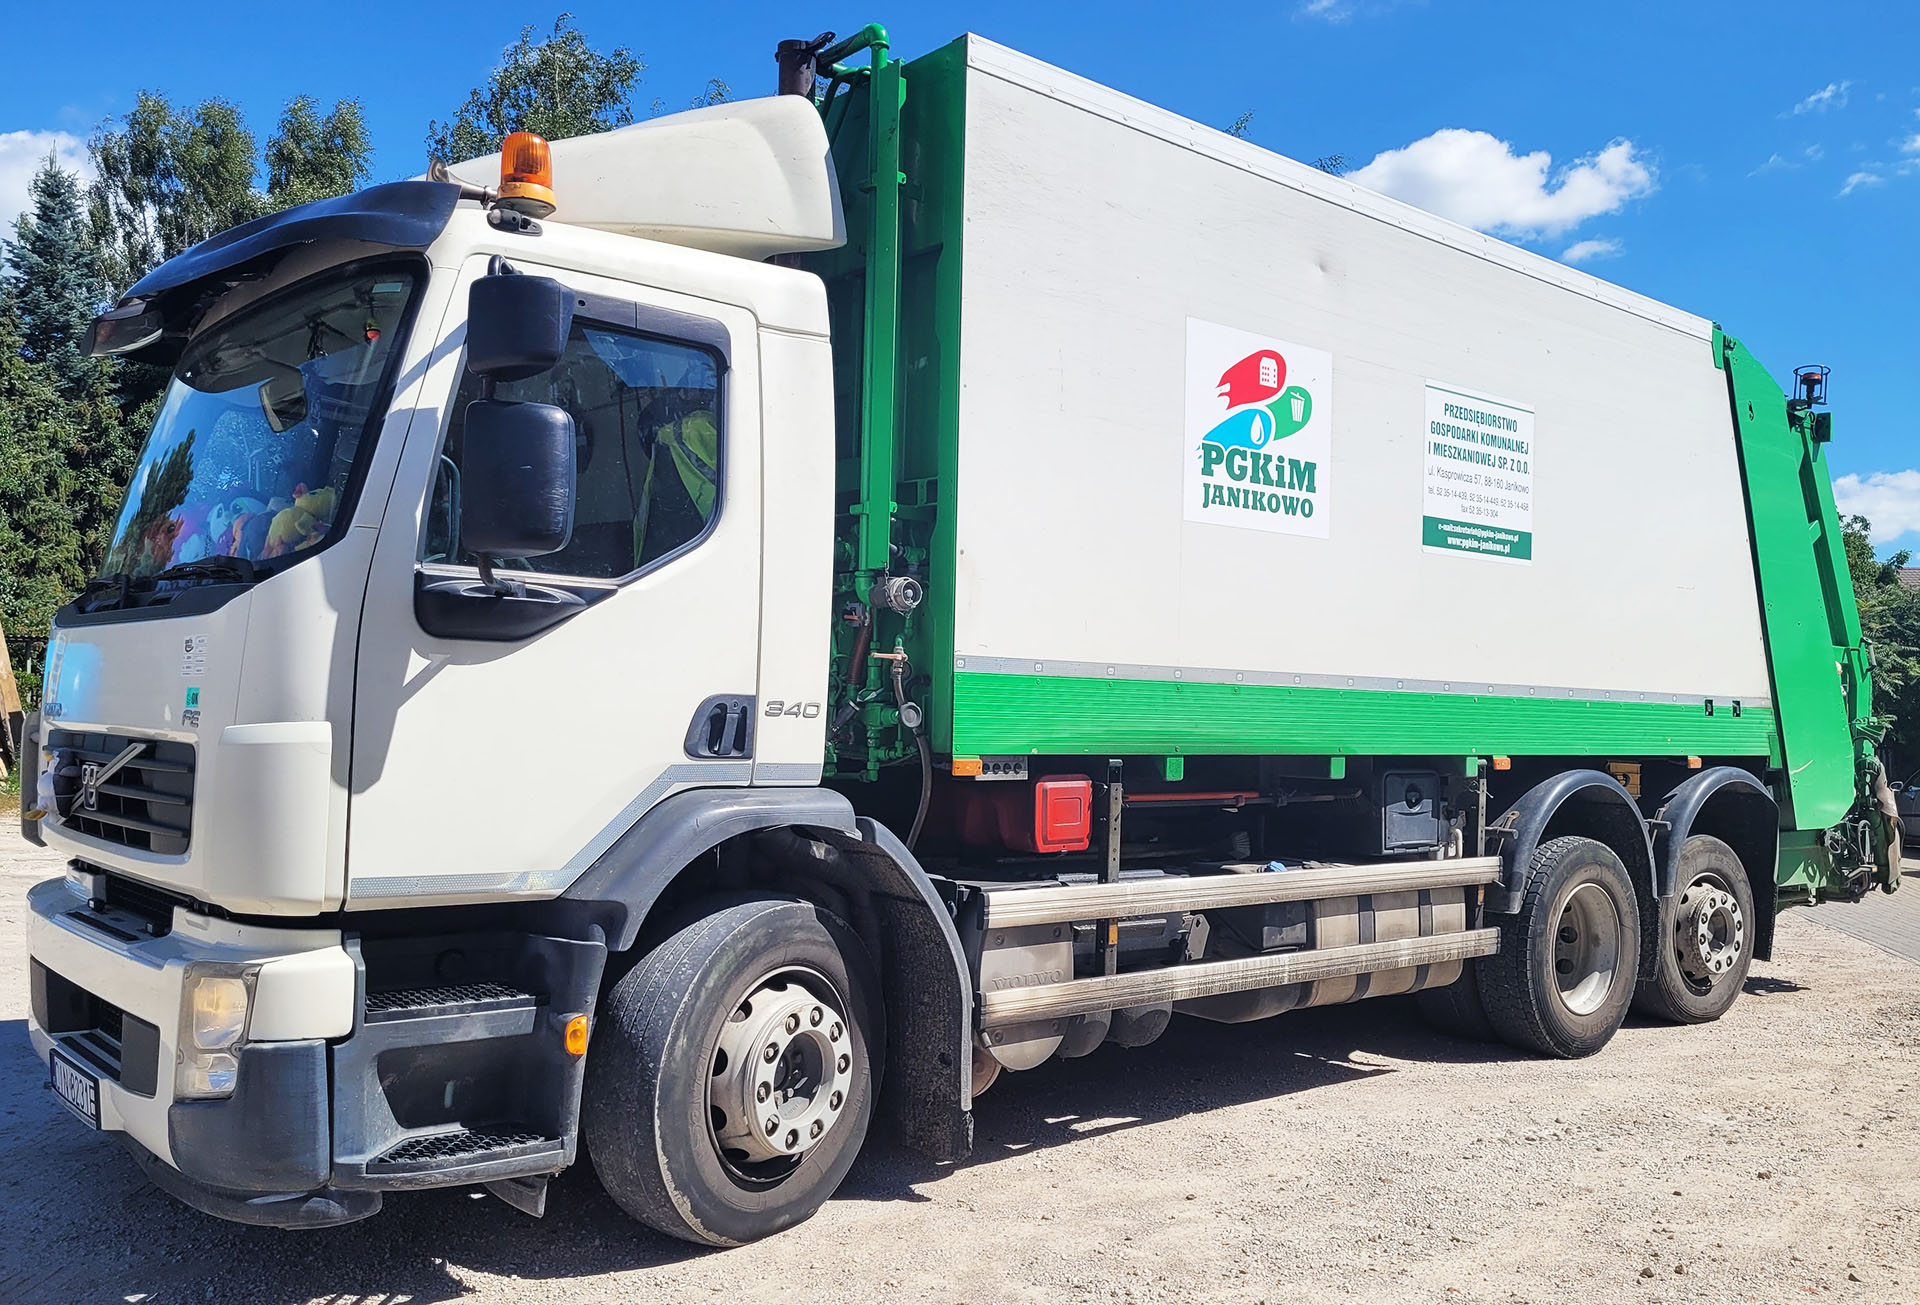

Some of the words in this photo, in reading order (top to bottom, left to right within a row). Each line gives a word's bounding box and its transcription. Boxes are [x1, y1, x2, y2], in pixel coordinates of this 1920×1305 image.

[1444, 403, 1518, 432] PRZEDSIĘBIORSTWO
[1430, 420, 1479, 444] GOSPODARKI
[1480, 432, 1529, 455] KOMUNALNEJ
[1201, 442, 1317, 494] PGKiM
[1428, 441, 1431, 455] I
[1433, 442, 1496, 468] MIESZKANIOWEJ
[1498, 456, 1509, 471] SP.
[1510, 458, 1515, 472] Z
[1427, 465, 1435, 477] ul.
[1436, 466, 1473, 484] Kasprowicza
[1484, 475, 1504, 490] 88-160
[1504, 480, 1530, 495] Janikowo
[1202, 482, 1314, 518] JANIKOWO
[1436, 486, 1443, 497] 52
[1469, 491, 1476, 502] 52
[1500, 498, 1507, 508] 52
[1469, 504, 1475, 514] 52
[1447, 536, 1511, 554] www.pgkim-janikowo.pl
[181, 709, 201, 728] FE
[764, 700, 821, 719] 340
[991, 968, 1065, 990] VOLVO
